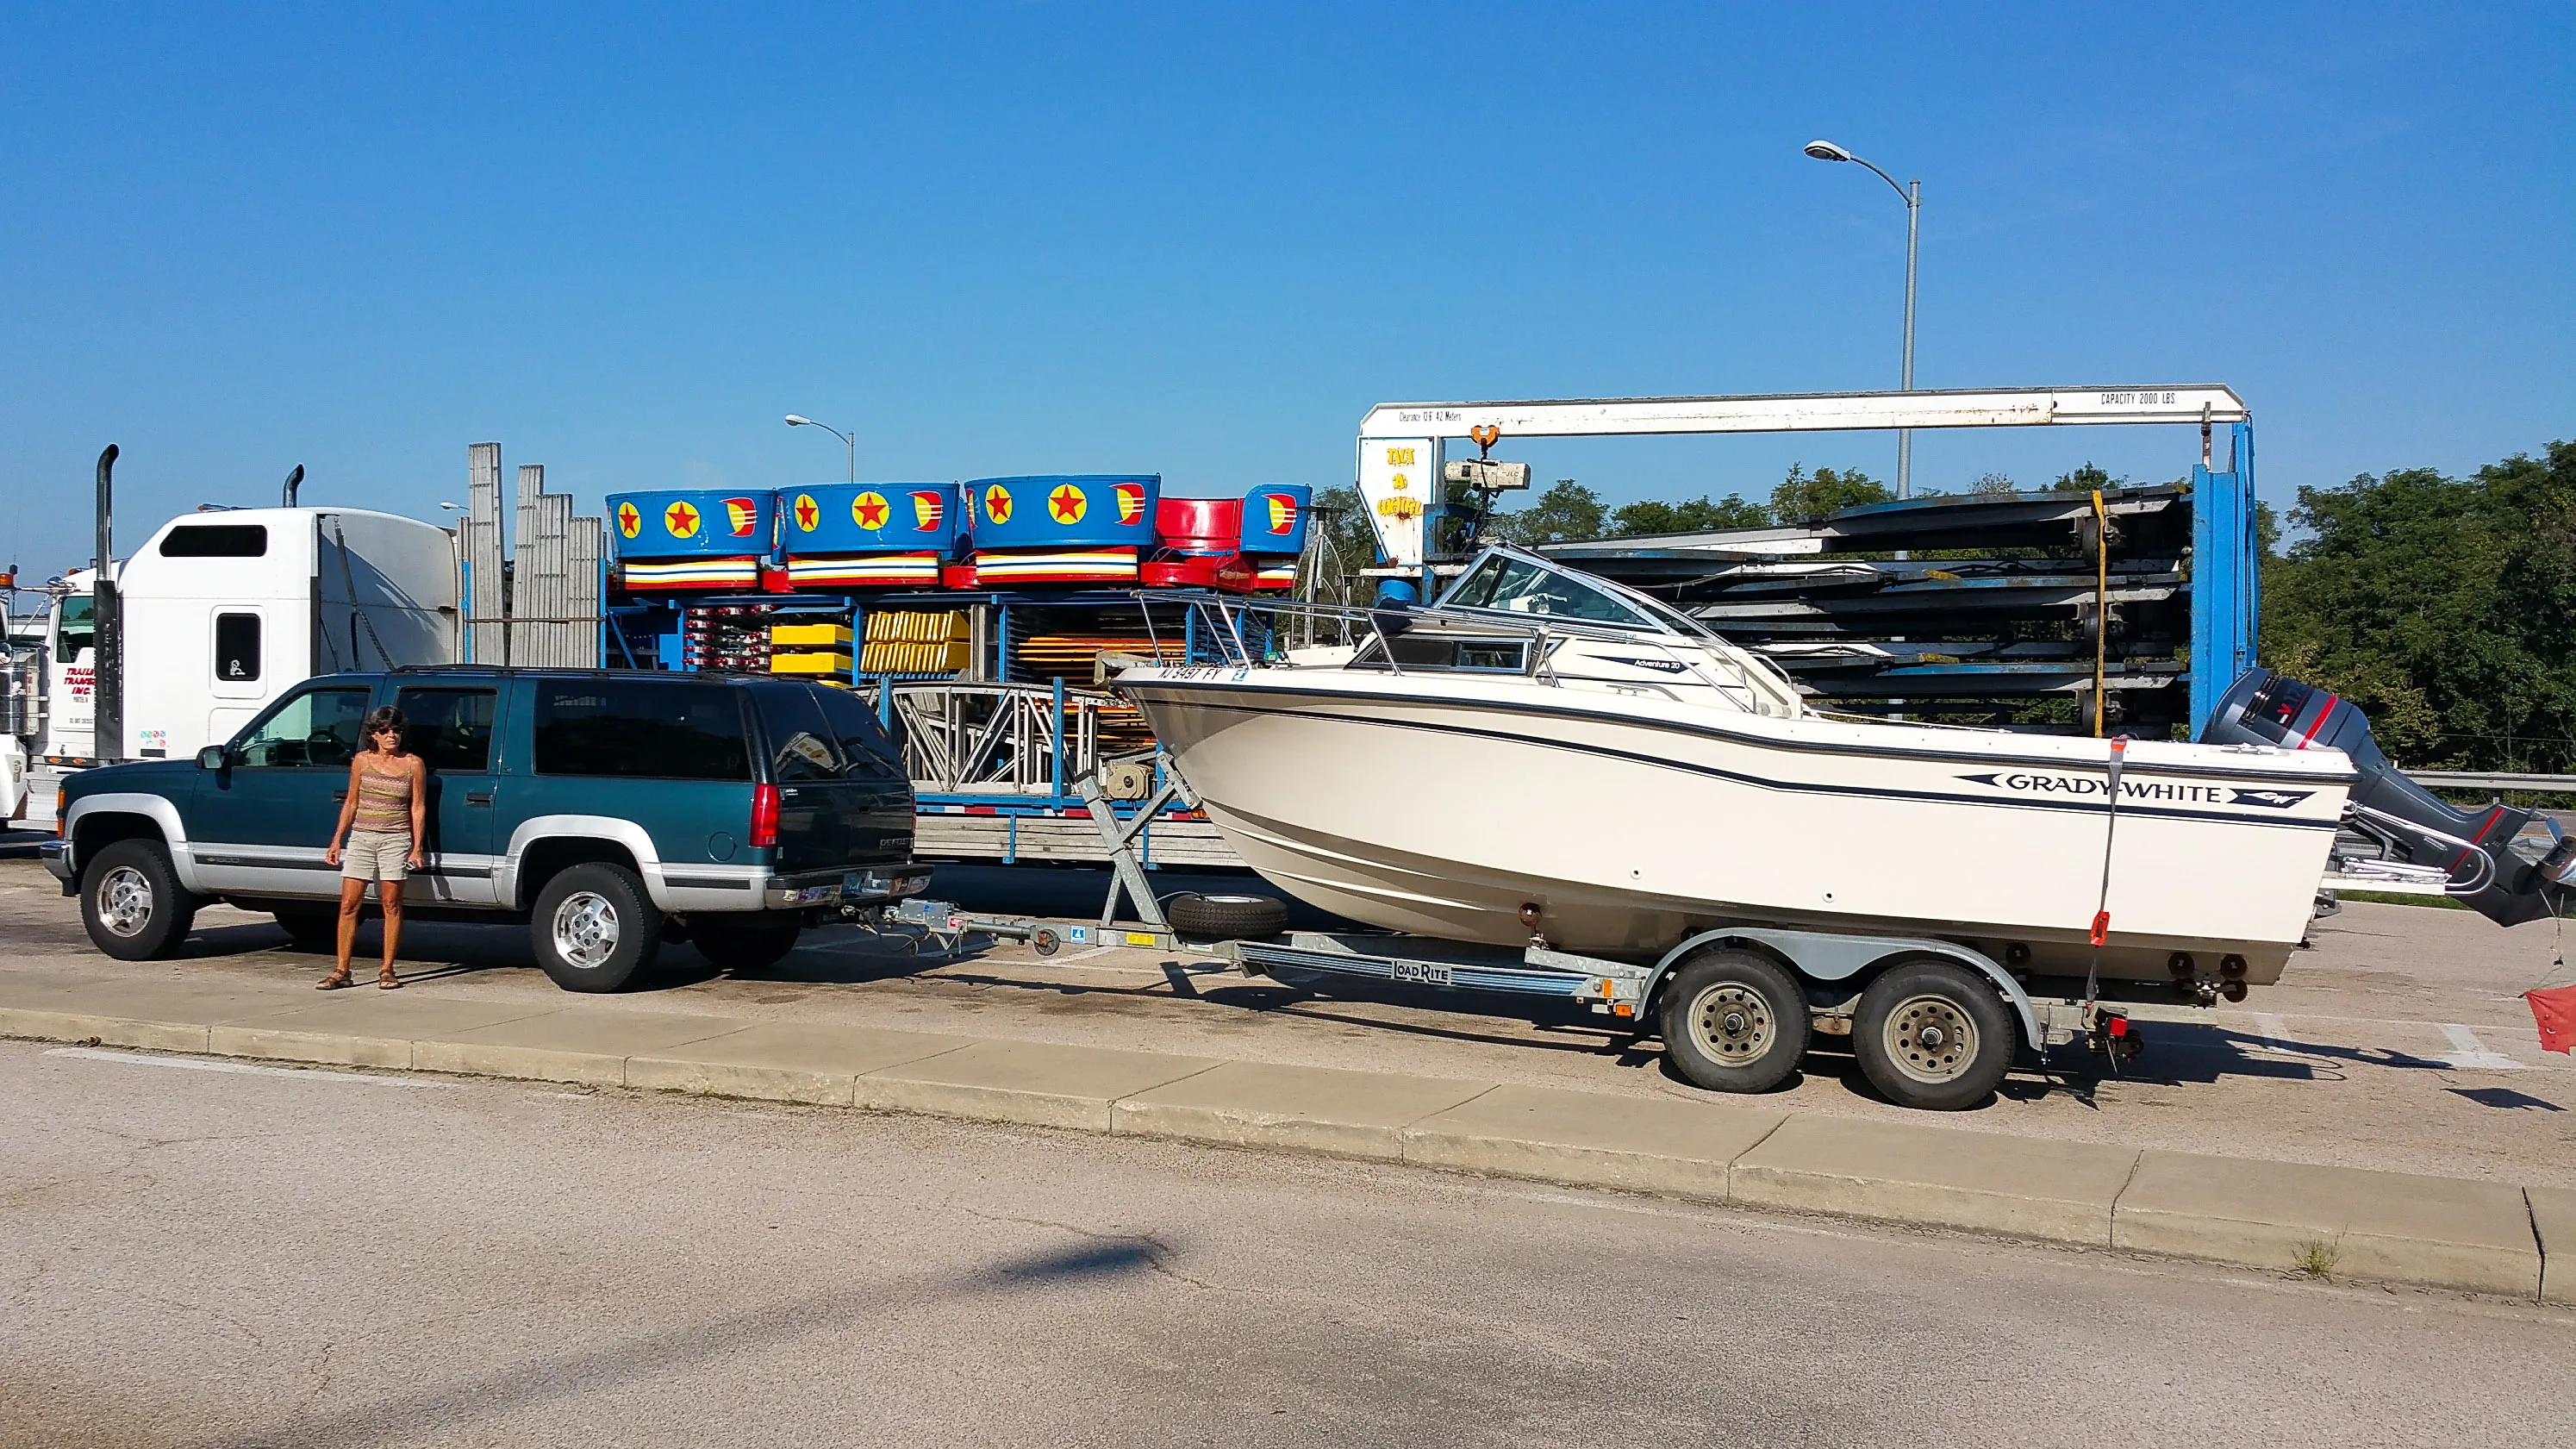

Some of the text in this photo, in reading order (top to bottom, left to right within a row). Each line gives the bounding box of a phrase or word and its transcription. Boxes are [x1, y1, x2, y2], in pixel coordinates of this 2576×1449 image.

[2101, 392, 2176, 404] CAPACITY 2000 LBS
[1445, 411, 1461, 422] Meters
[1393, 473, 1407, 490] A
[1634, 659, 1670, 668] Adventure
[1158, 668, 1173, 678] NJ
[1202, 668, 1223, 680] FY
[2005, 774, 2222, 803] GRADY-WHITE
